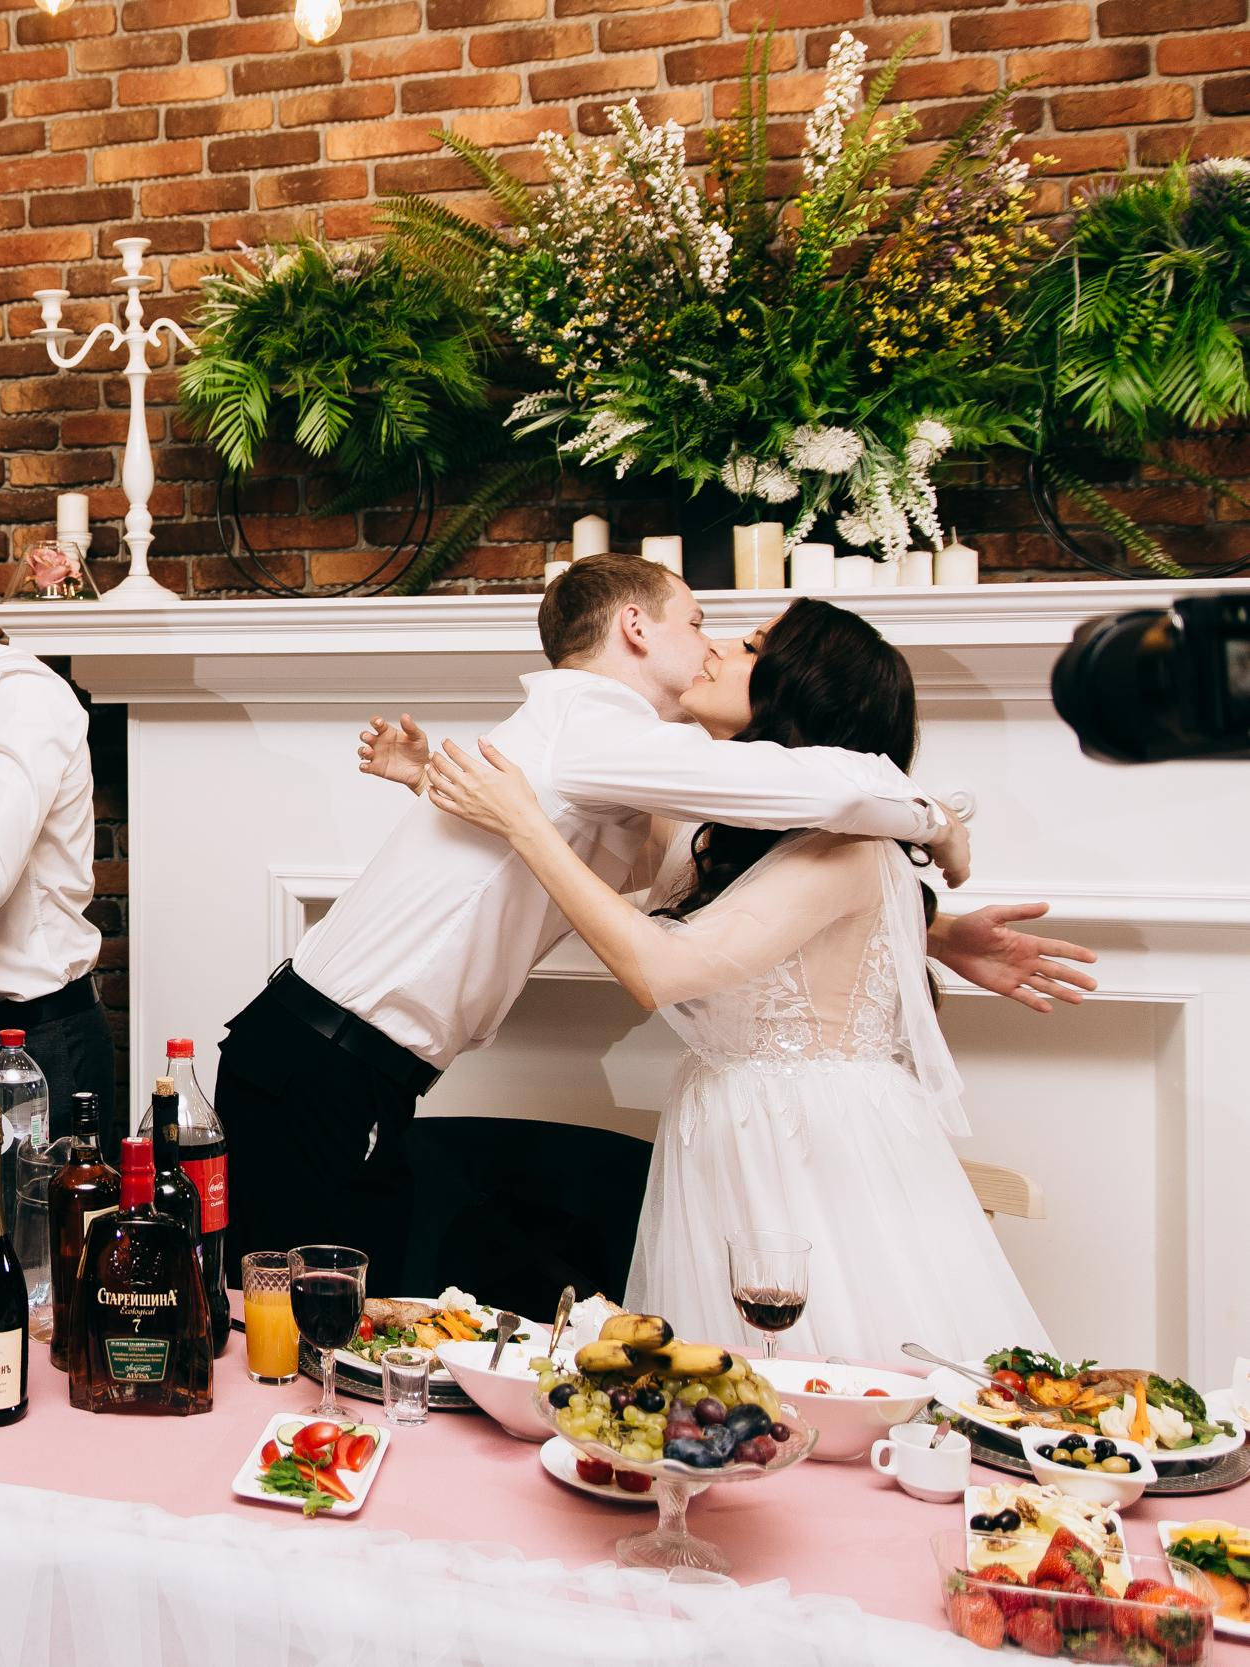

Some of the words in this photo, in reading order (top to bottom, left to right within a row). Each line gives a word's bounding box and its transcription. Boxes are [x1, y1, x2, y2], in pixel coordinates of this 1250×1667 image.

[97, 1287, 177, 1306] СТАРЕЙШИНА
[120, 1306, 156, 1318] Ecological
[132, 1318, 141, 1333] 7
